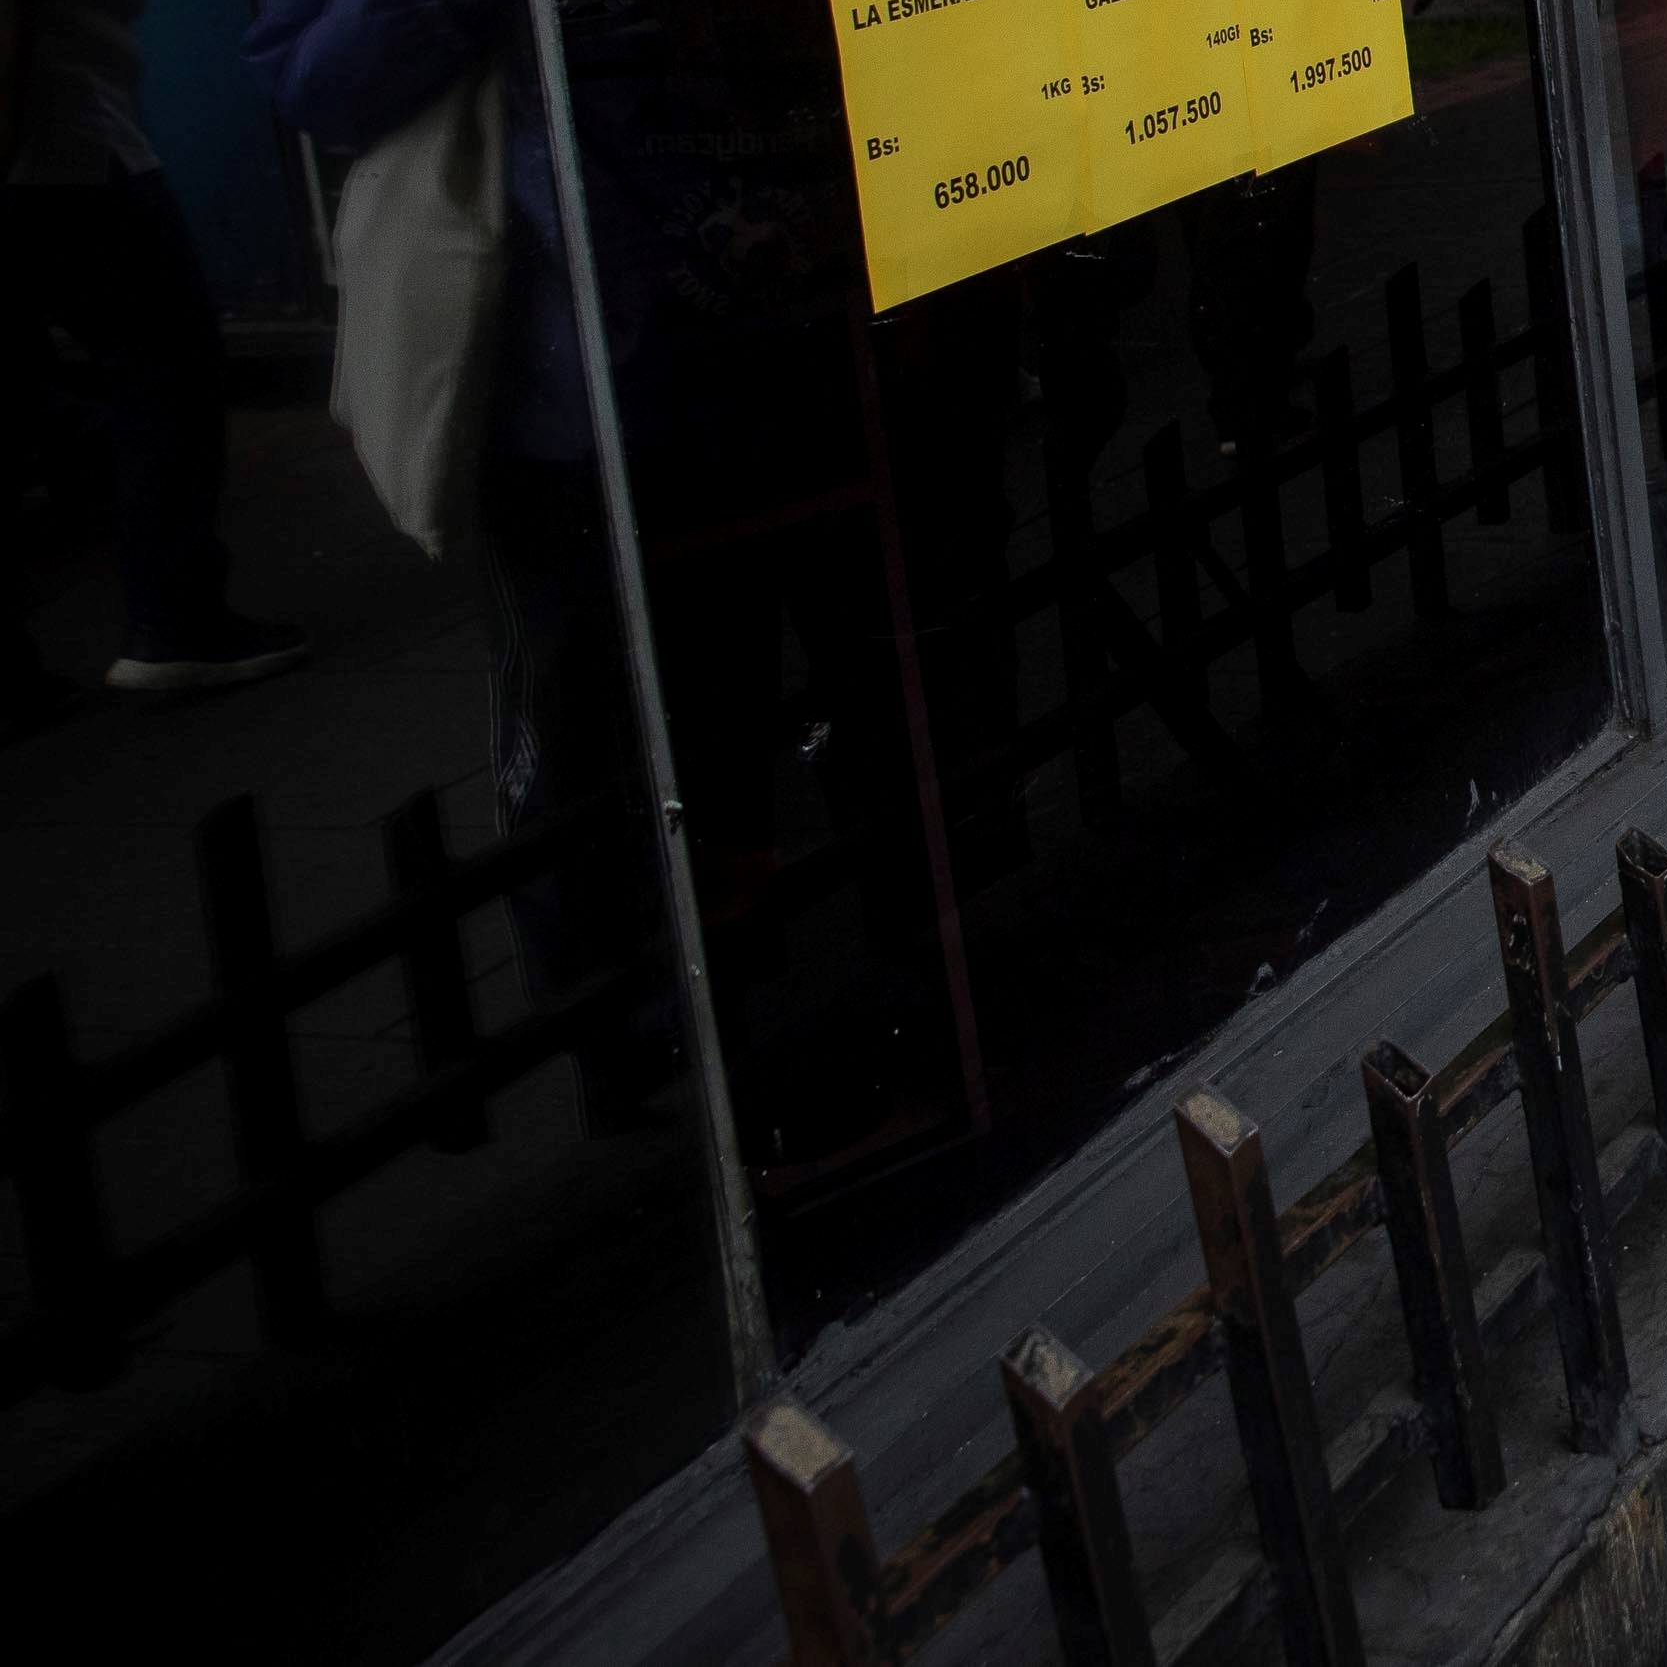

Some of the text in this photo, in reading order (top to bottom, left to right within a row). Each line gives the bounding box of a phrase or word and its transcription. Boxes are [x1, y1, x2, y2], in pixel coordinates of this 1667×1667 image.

[850, 3, 883, 32] LA
[1289, 45, 1373, 94] 1.997.500
[1041, 78, 1072, 101] 1KG
[1124, 90, 1223, 146] 1.057.500
[865, 135, 901, 162] Bs:
[933, 154, 1031, 211] 658.000
